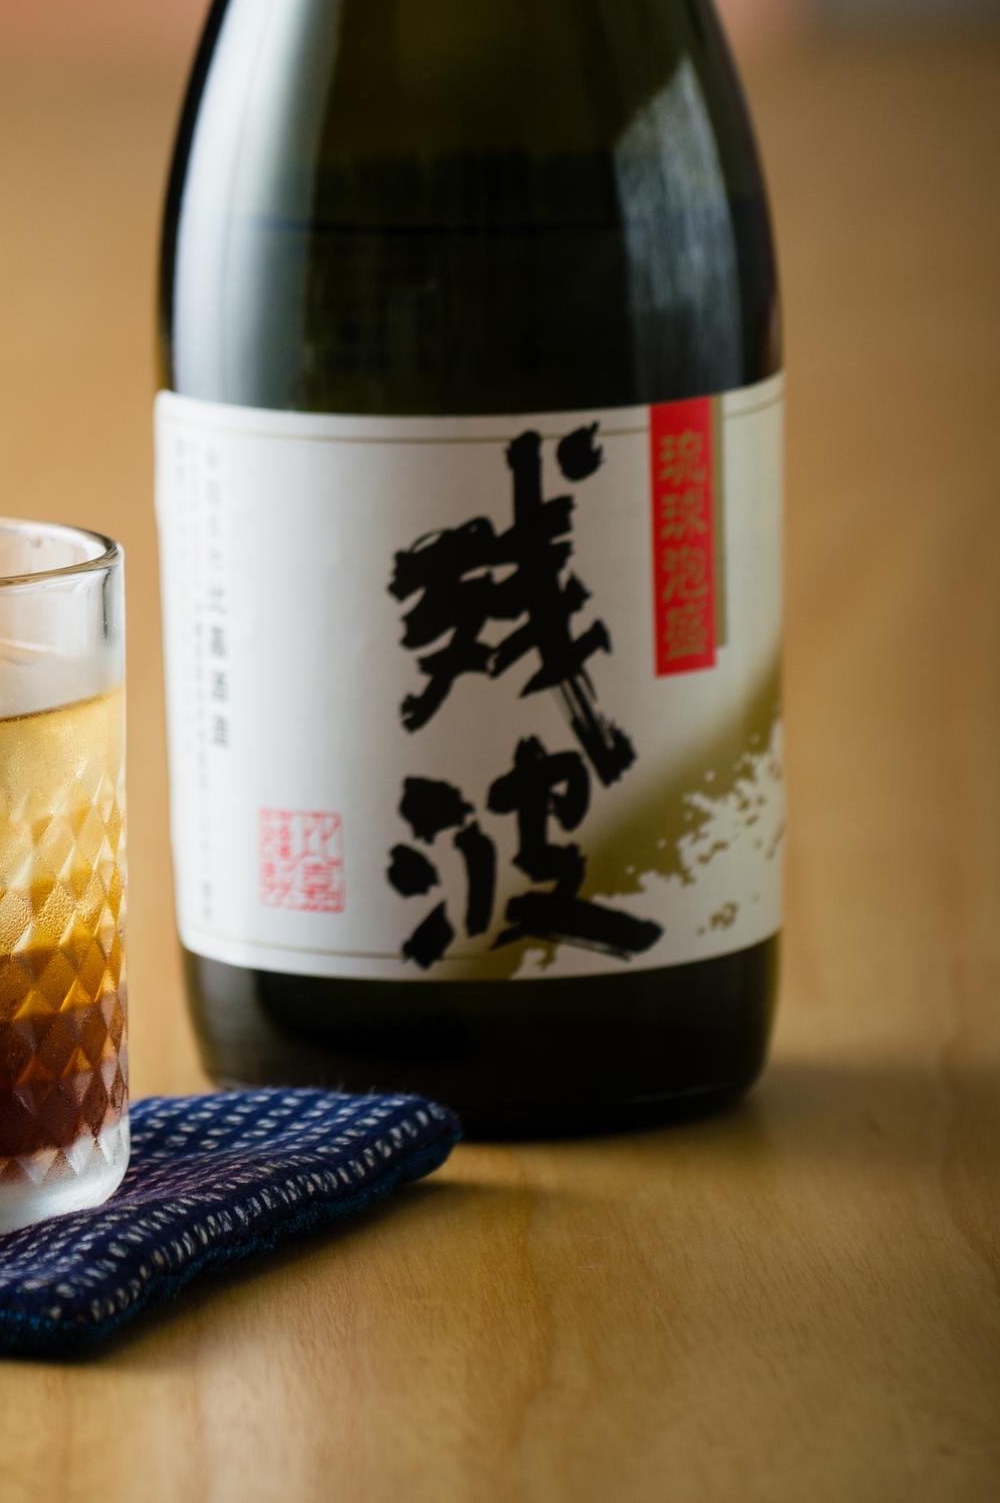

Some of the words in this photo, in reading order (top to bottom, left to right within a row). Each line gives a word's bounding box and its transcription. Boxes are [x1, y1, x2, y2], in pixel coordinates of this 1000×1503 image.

[387, 421, 663, 970] 残波
[659, 430, 708, 662] 琉球泡盛
